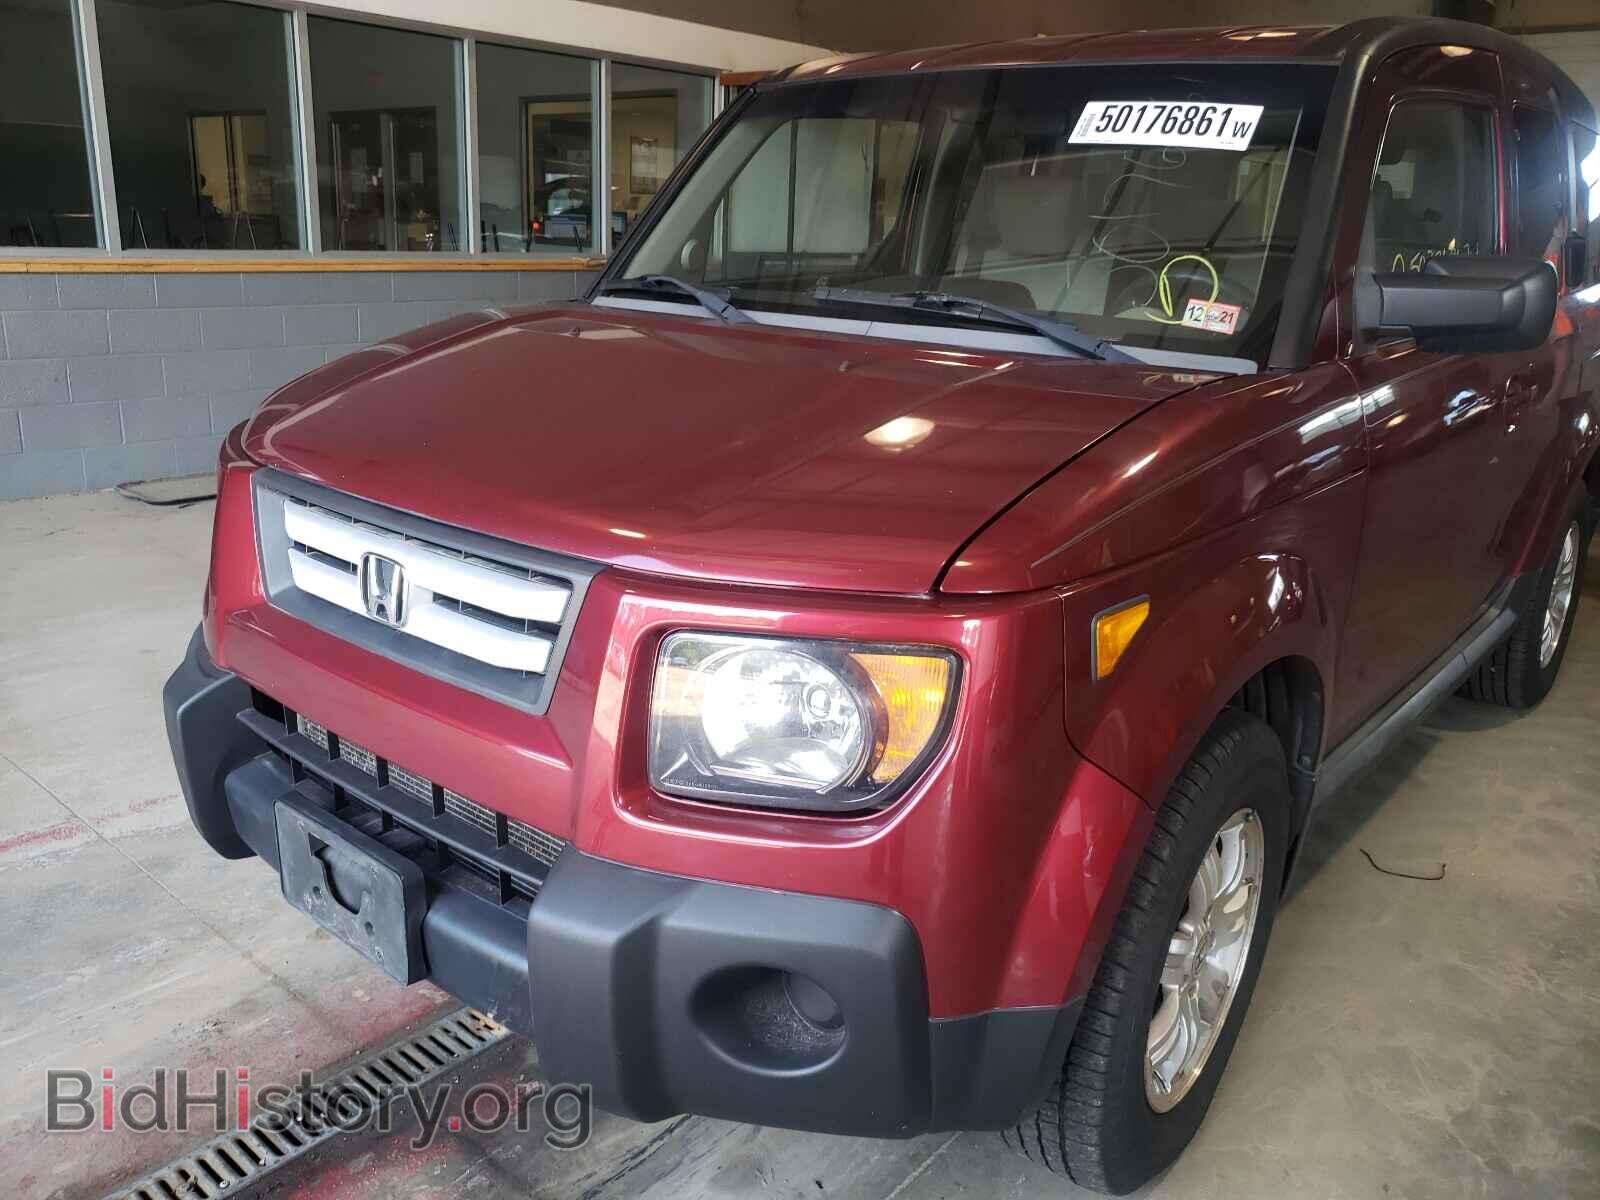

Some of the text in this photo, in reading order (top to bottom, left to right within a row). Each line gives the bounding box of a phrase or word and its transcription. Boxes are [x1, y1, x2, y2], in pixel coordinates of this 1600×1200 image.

[1095, 104, 1234, 138] 50176861
[1187, 305, 1205, 322] 12
[1219, 310, 1235, 324] 21
